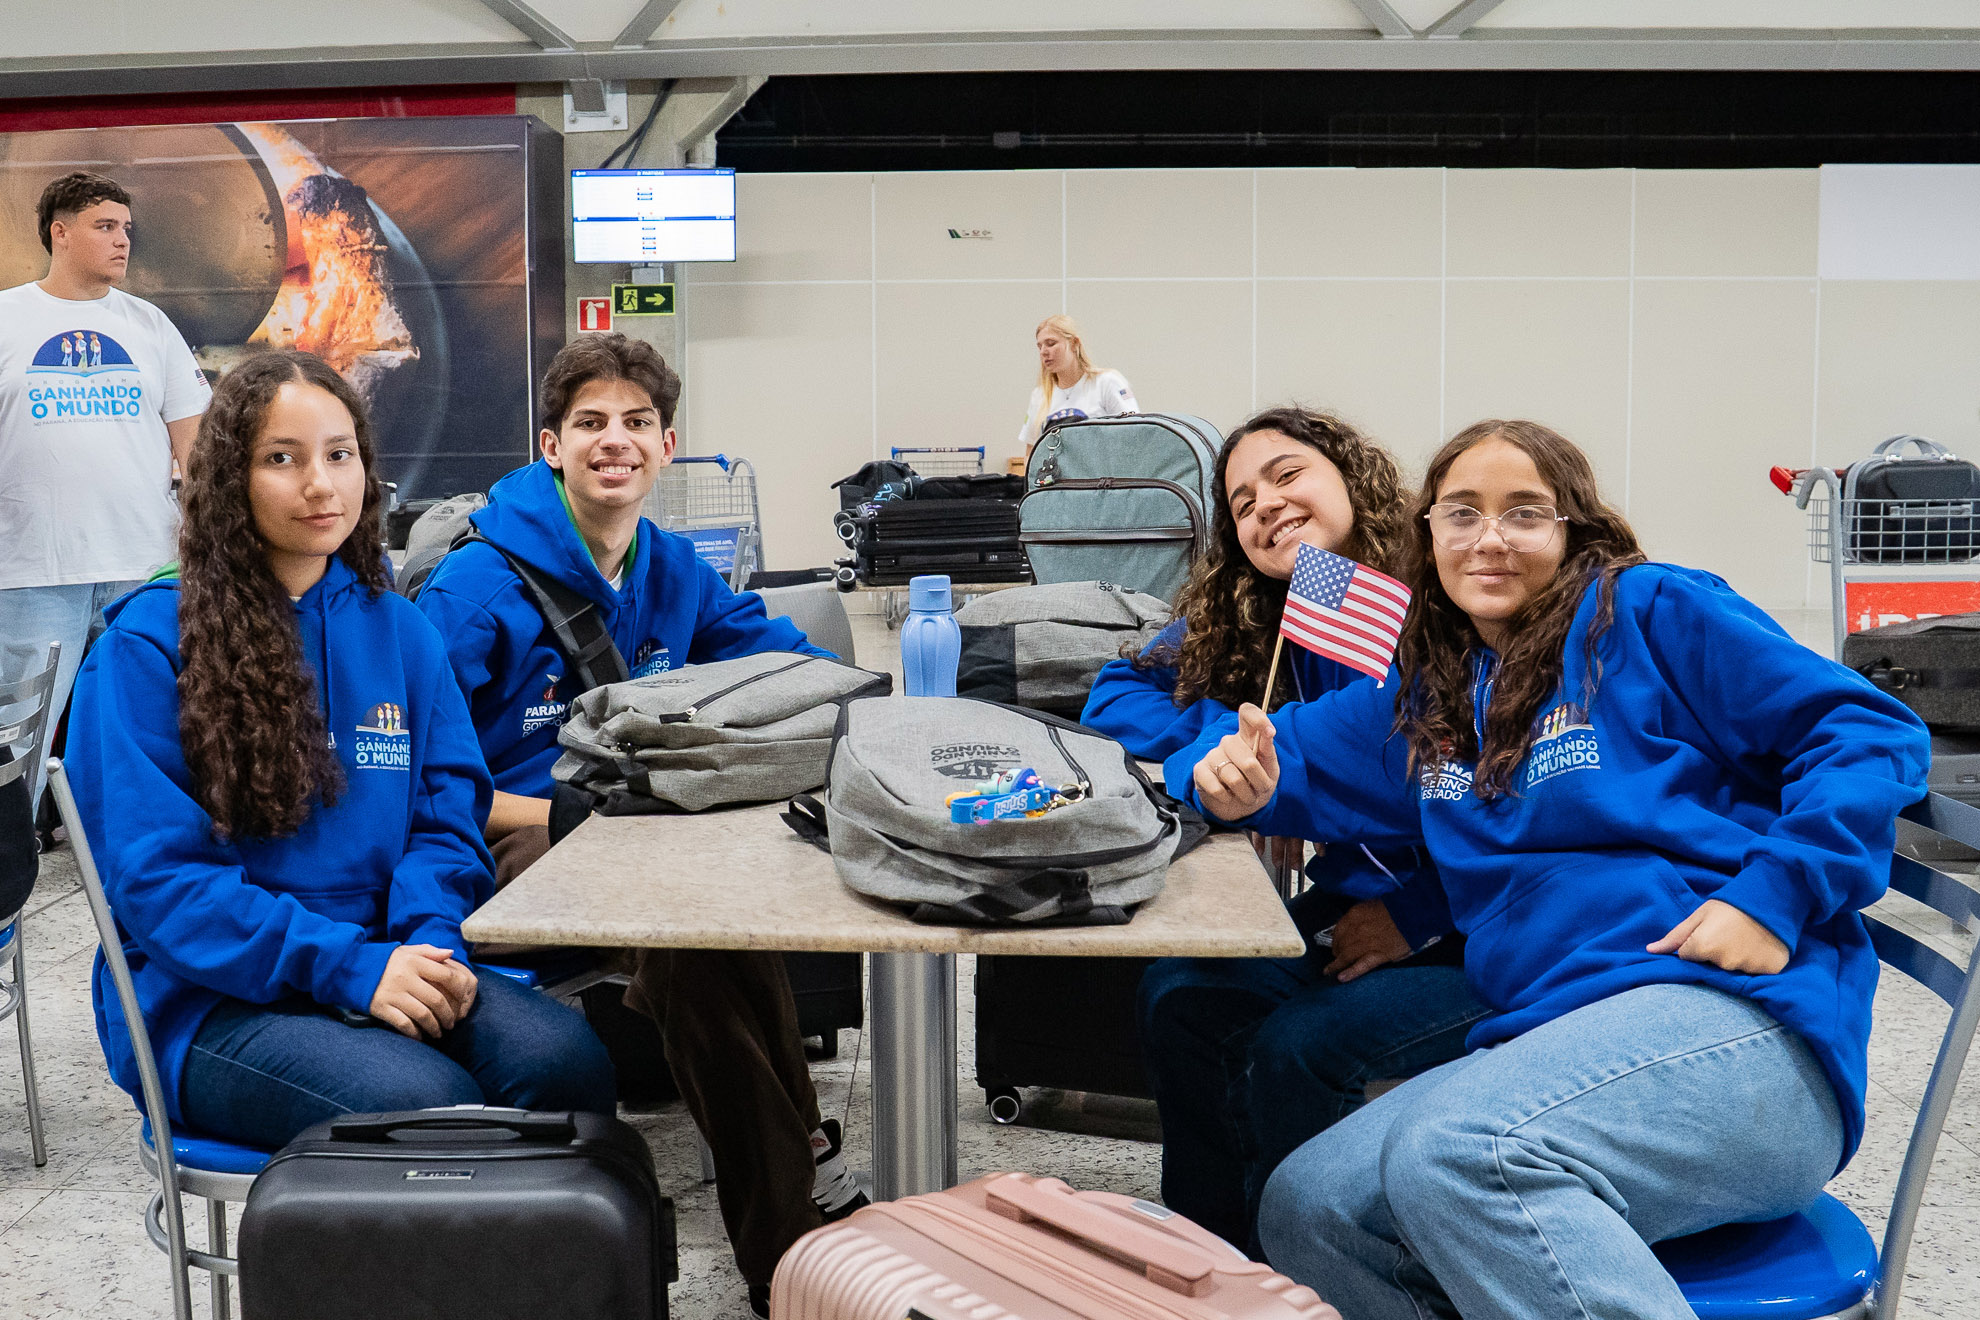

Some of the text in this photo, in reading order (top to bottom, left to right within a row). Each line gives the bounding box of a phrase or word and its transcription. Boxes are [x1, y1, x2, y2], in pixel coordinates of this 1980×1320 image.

[28, 385, 142, 402] GANHANDO
[31, 399, 140, 419] O MUNDO
[525, 702, 570, 717] PARAN
[356, 741, 410, 754] GANHAN
[931, 745, 1000, 755] MUNDO
[1528, 739, 1598, 770] GANHANDO
[356, 752, 410, 766] O MUND
[1527, 751, 1600, 783] O MUNDO
